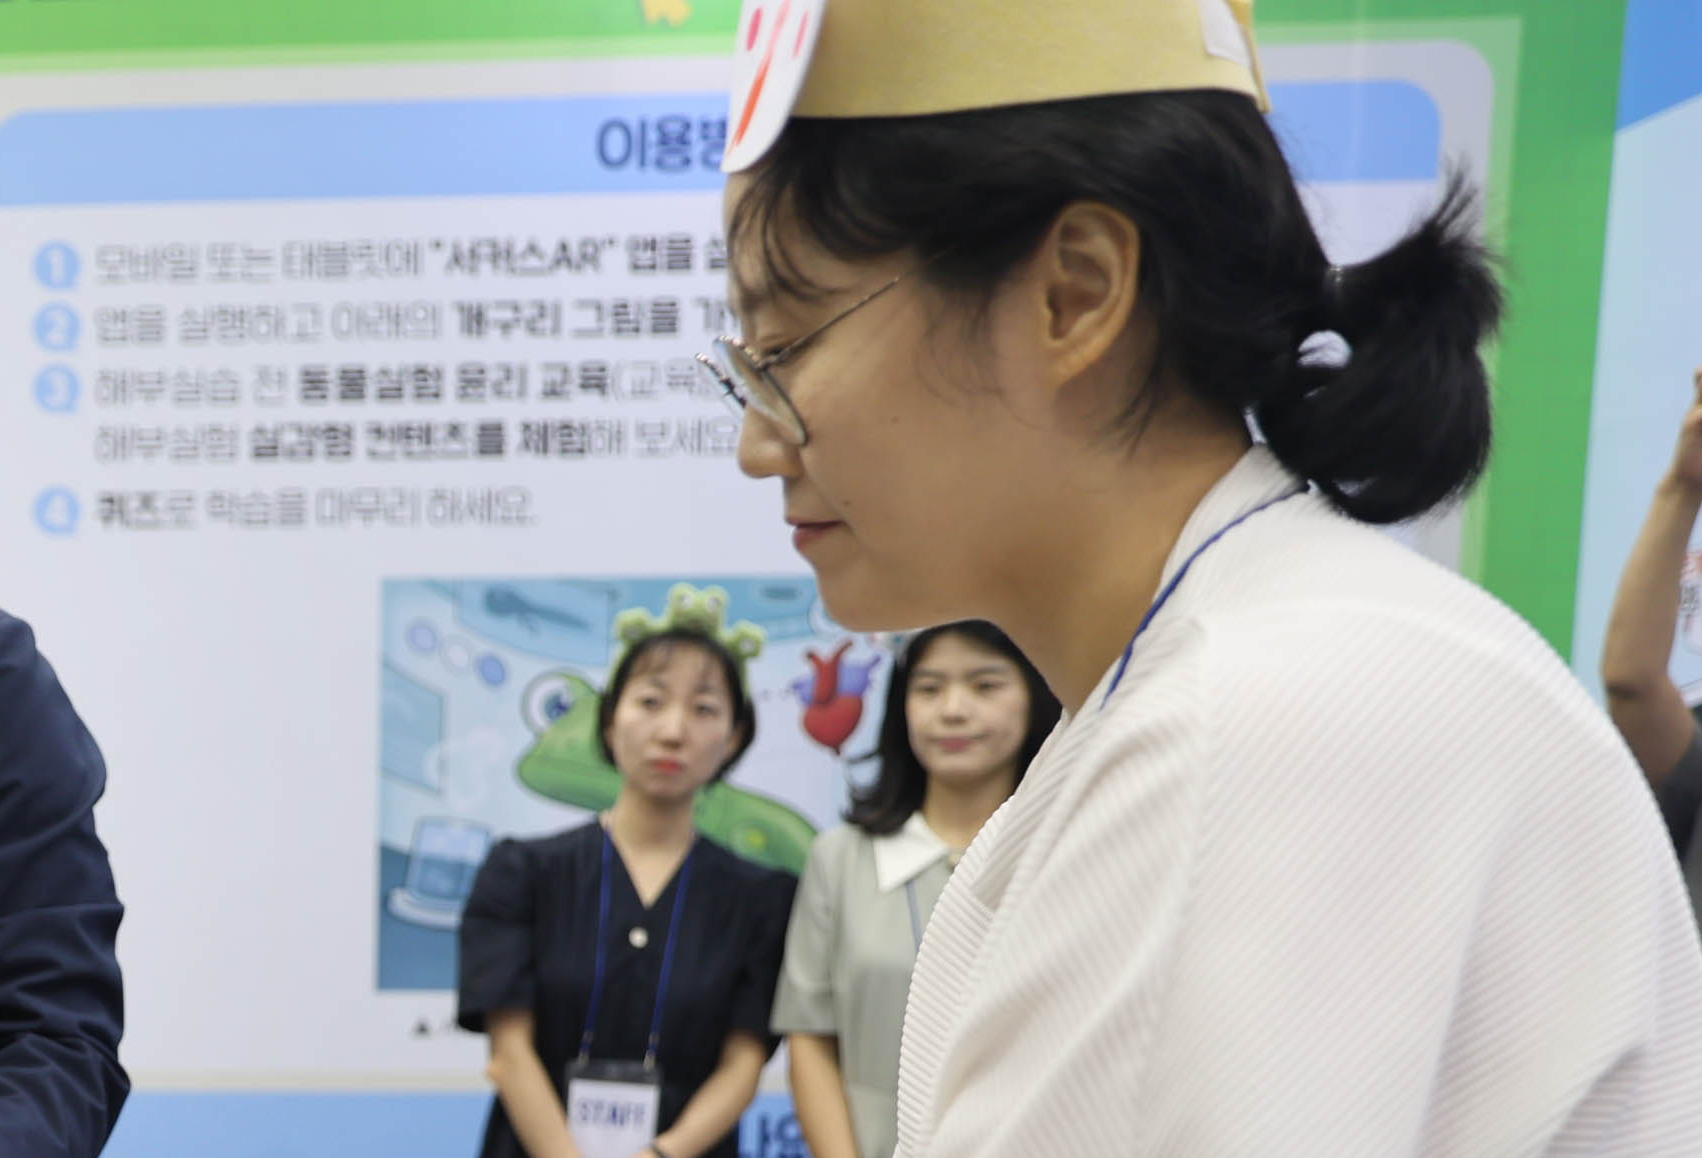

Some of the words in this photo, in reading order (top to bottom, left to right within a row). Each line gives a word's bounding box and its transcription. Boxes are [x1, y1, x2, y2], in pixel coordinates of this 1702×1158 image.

[97, 243, 196, 281] 모바일
[205, 242, 273, 281] 또는
[283, 239, 419, 279] 태블릿에
[628, 235, 693, 273] 앱을
[97, 305, 165, 344] 앱을
[178, 303, 321, 344] 실행하고
[333, 301, 438, 341] 아래의
[456, 299, 561, 338] 개구리
[571, 297, 677, 337] 그림을
[98, 368, 240, 405] 해부실습
[251, 367, 286, 404] 전
[302, 364, 441, 402] 동물실험
[456, 363, 526, 401] 윤리
[98, 426, 236, 462] 해부실험
[252, 423, 351, 461] 실감형
[365, 420, 504, 459] 컨텐츠를
[520, 418, 624, 457] 체험해
[98, 491, 195, 530] 퀴즈로
[207, 489, 304, 529] 학습을
[316, 487, 419, 527] 마무리
[427, 486, 538, 527] 하세요.
